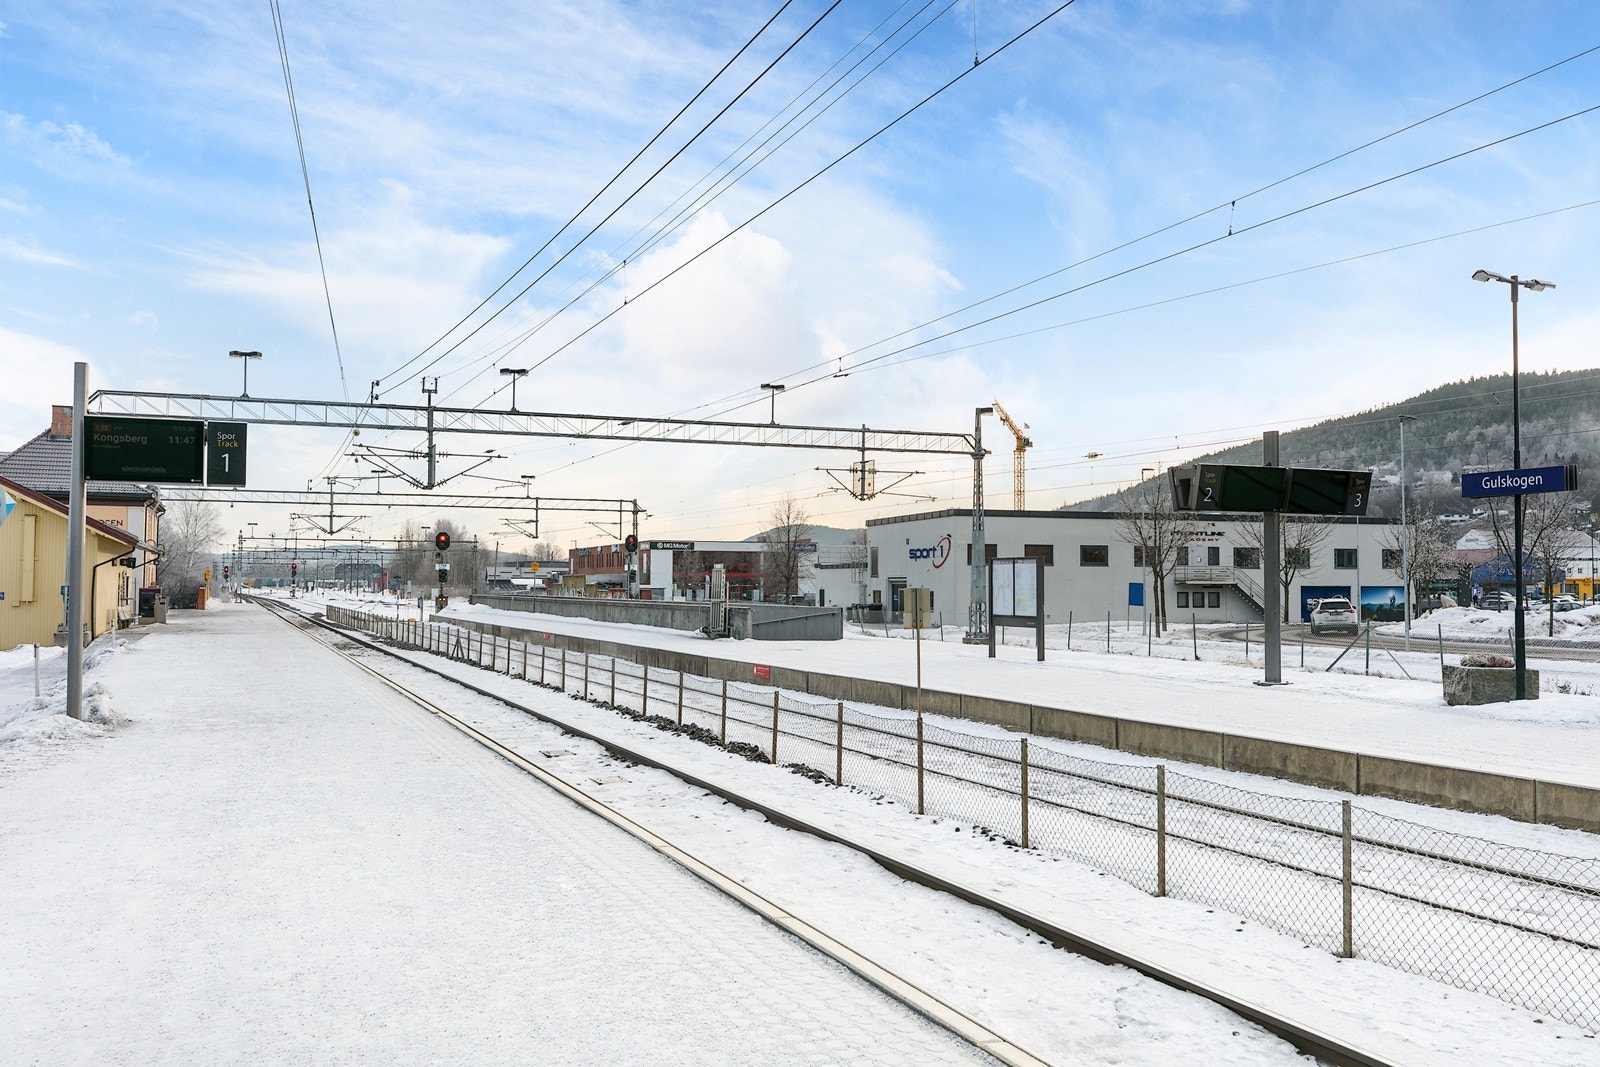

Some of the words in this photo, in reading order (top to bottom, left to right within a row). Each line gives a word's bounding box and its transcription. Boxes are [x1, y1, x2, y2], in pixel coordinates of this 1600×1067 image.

[93, 432, 148, 445] Kongsberg
[168, 436, 195, 445] 11:47
[217, 431, 236, 441] Spor
[217, 440, 239, 448] Track
[221, 453, 229, 473] 1
[1481, 474, 1543, 490] Gulskogen
[1203, 487, 1213, 502] 2
[1353, 493, 1362, 508] 3
